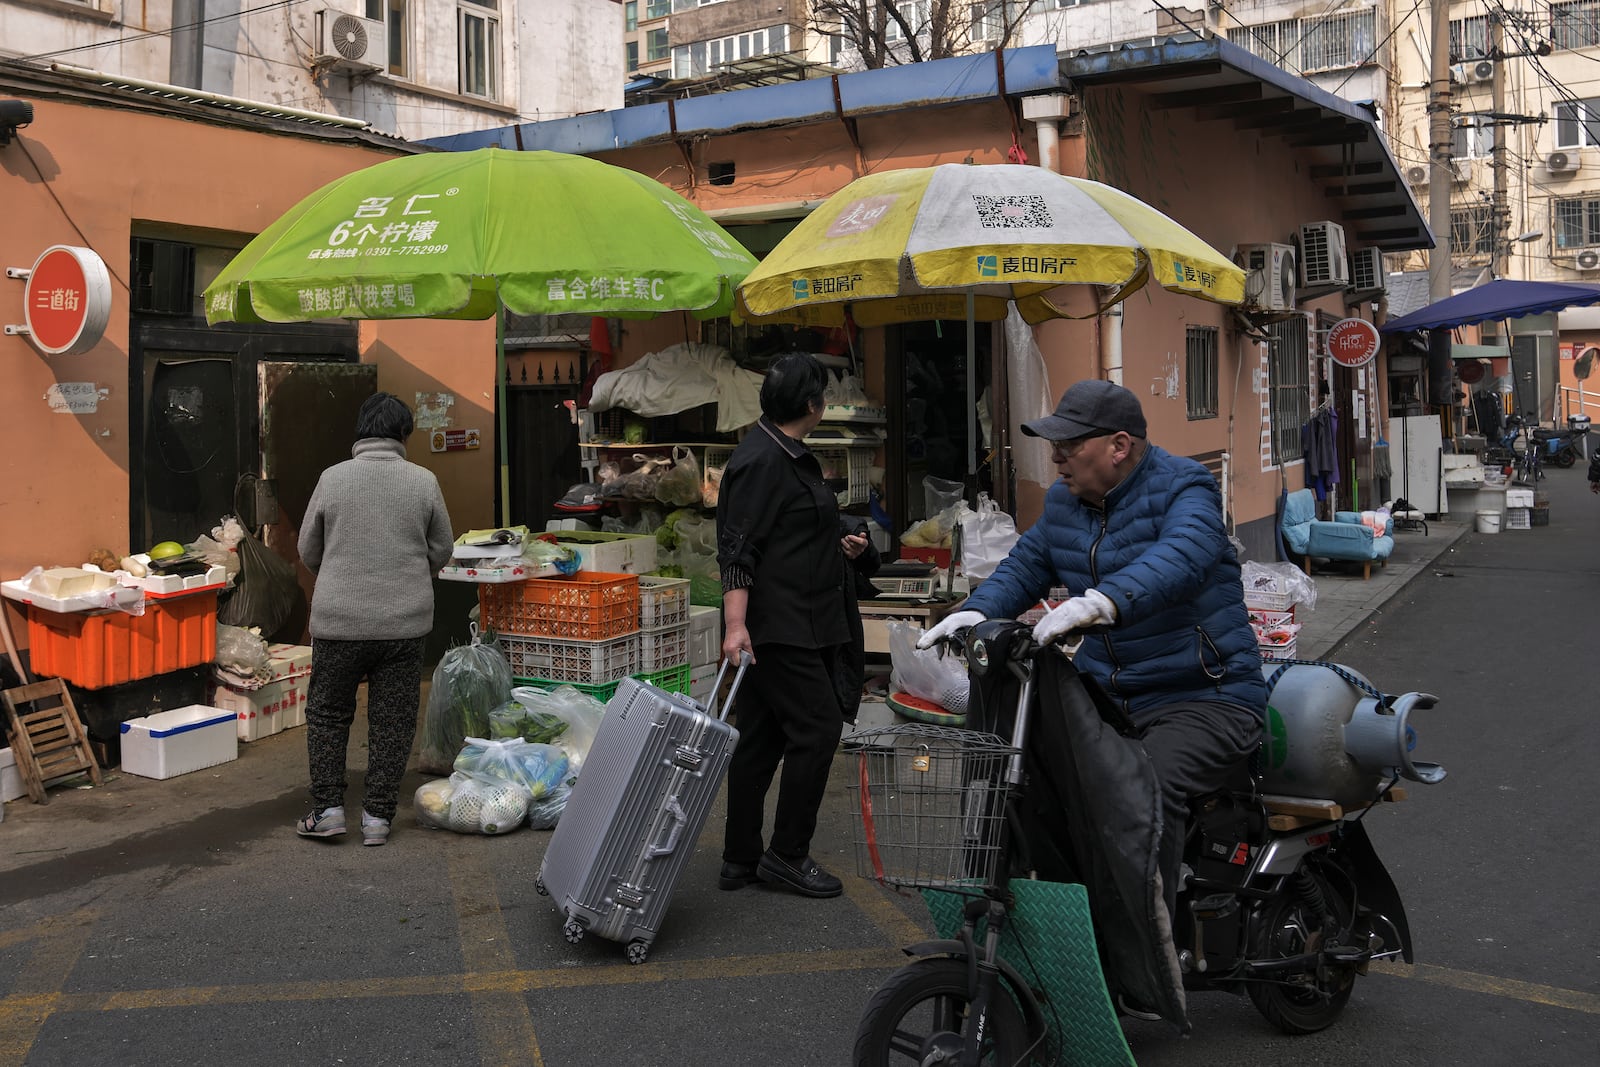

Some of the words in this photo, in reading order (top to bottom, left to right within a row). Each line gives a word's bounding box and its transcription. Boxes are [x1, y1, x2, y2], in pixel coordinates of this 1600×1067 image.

[328, 220, 440, 246] 6个柠檬
[1002, 256, 1077, 275] 麦田房产
[546, 276, 664, 301] 富含维生素C
[812, 274, 863, 295] 麦田房产
[36, 288, 79, 312] 三道街
[298, 283, 416, 313] 酸酸甜甜我爱喝
[1329, 320, 1358, 344] JIANWAI
